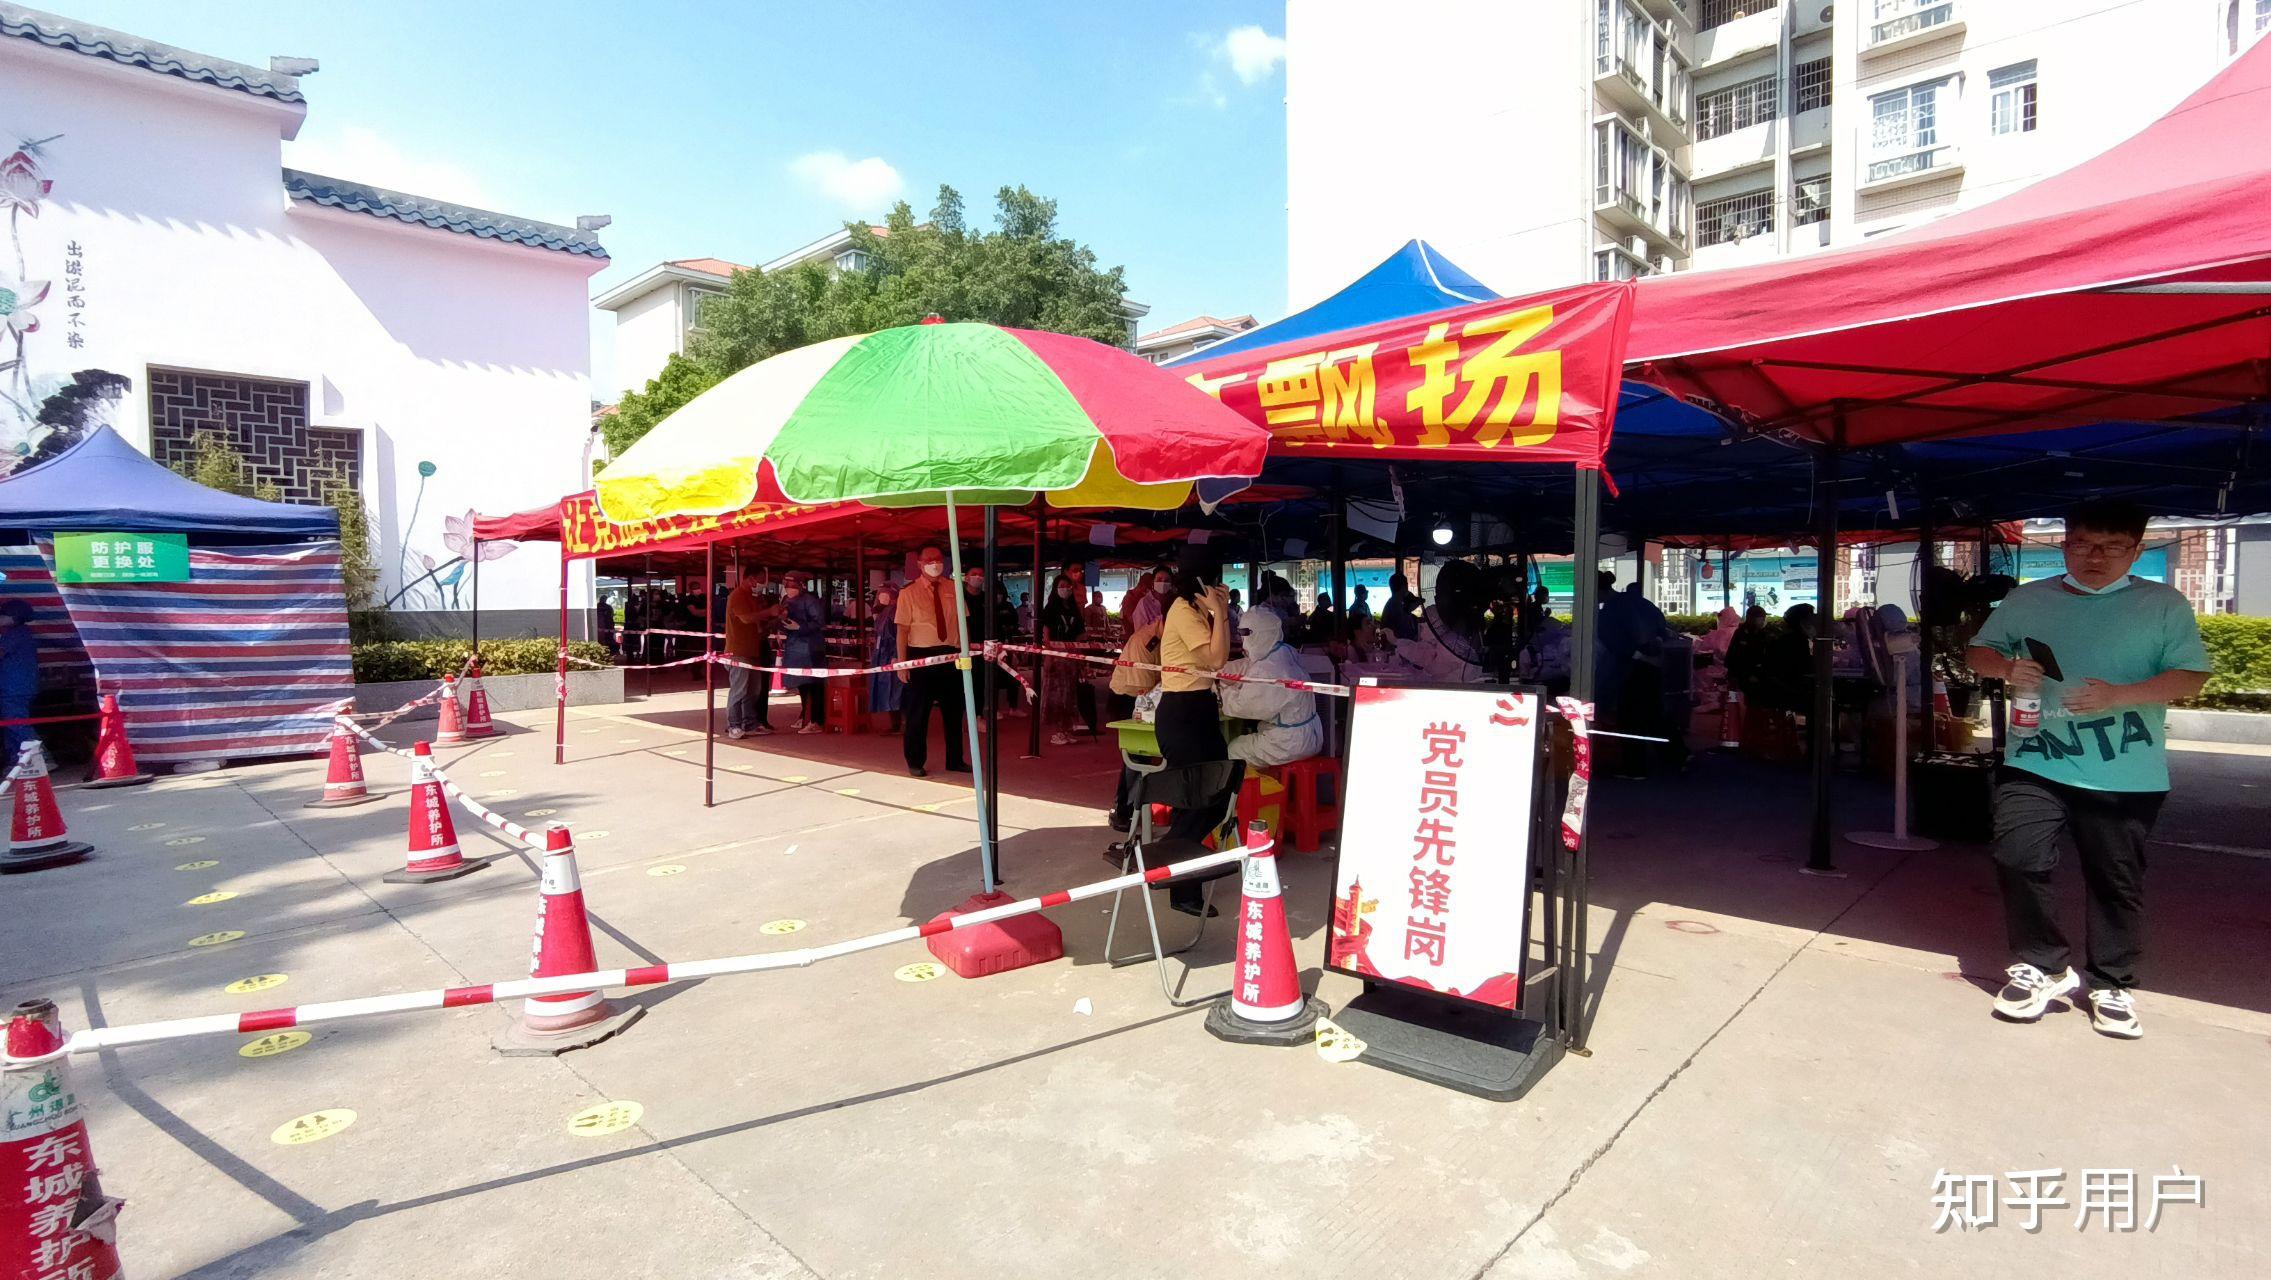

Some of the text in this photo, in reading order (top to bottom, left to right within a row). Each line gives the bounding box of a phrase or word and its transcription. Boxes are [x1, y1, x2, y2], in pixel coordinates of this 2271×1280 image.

[91, 541, 155, 555] 防护服
[92, 555, 156, 569] 更换处
[2015, 711, 2153, 762] ANTA
[23, 781, 42, 838] 东城养护所
[425, 784, 444, 846] 东城养护所
[1404, 721, 1467, 967] 党员先锋岗
[1243, 901, 1264, 1003] 东城养护所
